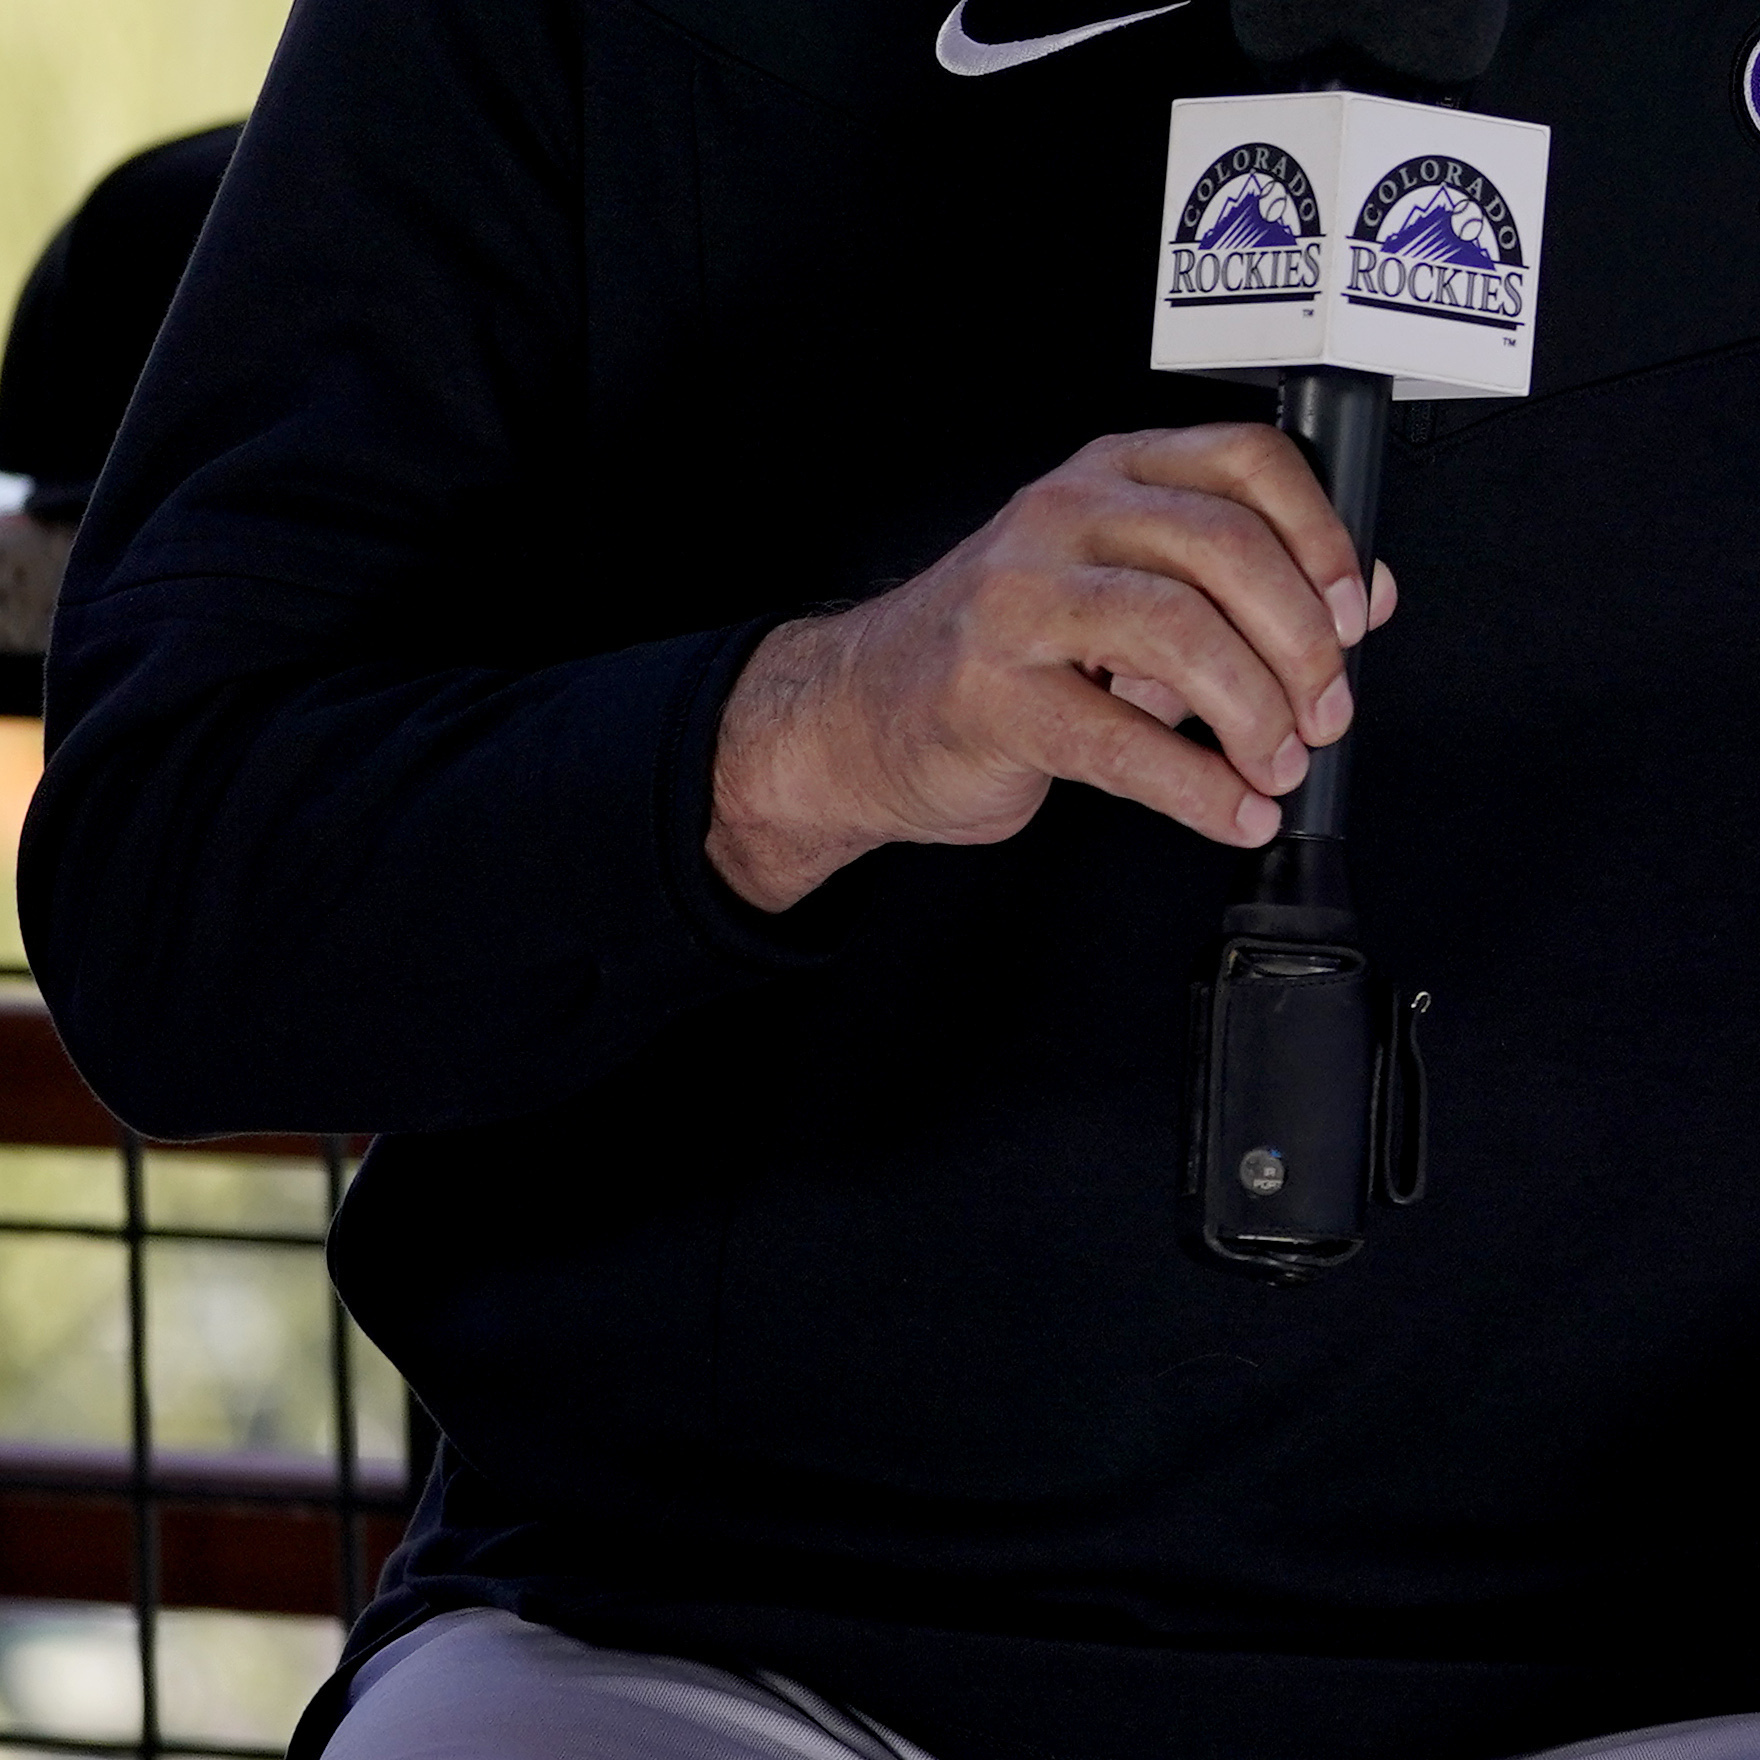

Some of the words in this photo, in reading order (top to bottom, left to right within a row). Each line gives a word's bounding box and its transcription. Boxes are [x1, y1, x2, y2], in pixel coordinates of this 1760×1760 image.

[1183, 146, 1316, 228] COLORADO
[1362, 158, 1517, 250] COLORADO
[1169, 242, 1321, 294] ROCKIES
[1346, 245, 1523, 318] ROCKIES
